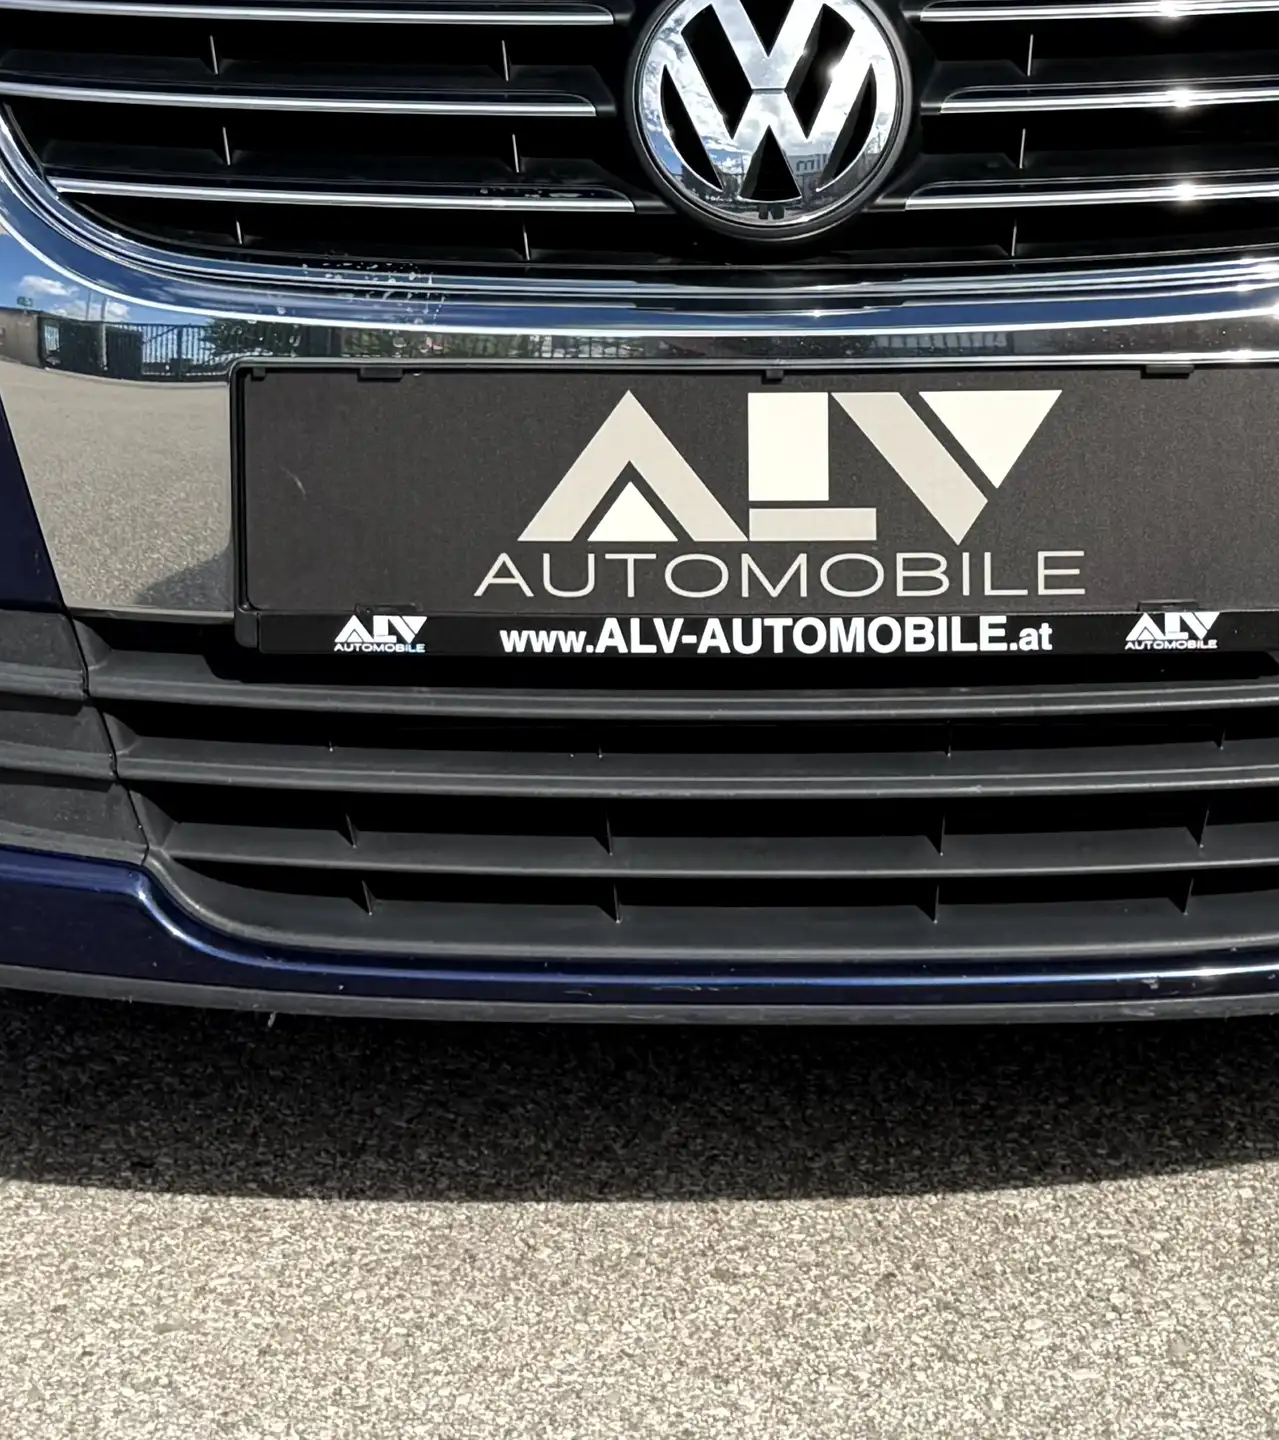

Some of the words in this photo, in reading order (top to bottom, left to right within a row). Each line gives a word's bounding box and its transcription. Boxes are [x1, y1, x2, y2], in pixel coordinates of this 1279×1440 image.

[518, 389, 1063, 545] ALV
[473, 550, 1086, 598] AUTOMOBILE
[334, 614, 428, 643] ALV
[500, 615, 1053, 654] www.ALV-AUTOMOBILE.at
[1125, 611, 1220, 641] ALV
[333, 642, 426, 653] AUTOMOBILE
[1124, 639, 1218, 650] AUTOMOBILE
